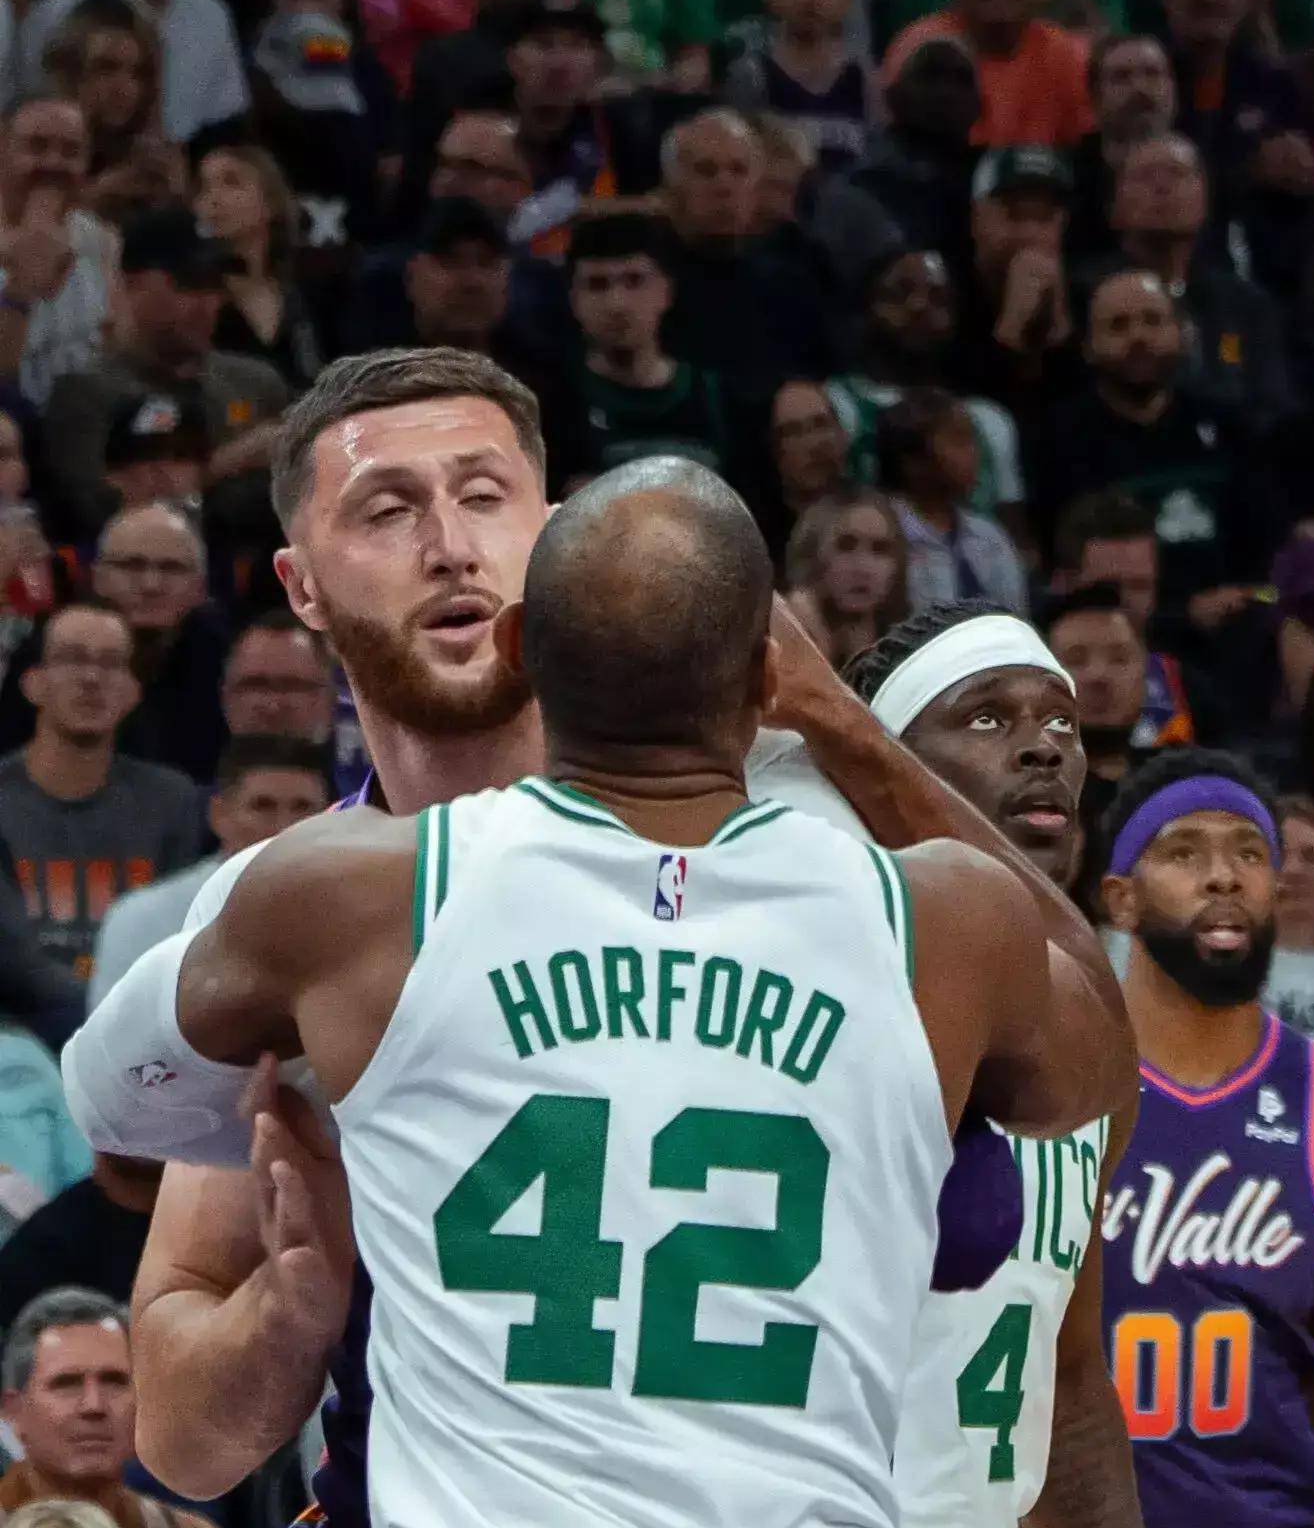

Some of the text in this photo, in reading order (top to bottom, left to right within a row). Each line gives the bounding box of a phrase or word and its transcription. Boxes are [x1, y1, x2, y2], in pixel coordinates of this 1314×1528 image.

[487, 946, 846, 1085] HORFORD
[434, 1093, 829, 1410] 42
[1131, 1150, 1305, 1286] Valle
[957, 1303, 1032, 1482] 4
[1111, 1308, 1253, 1442] 00
